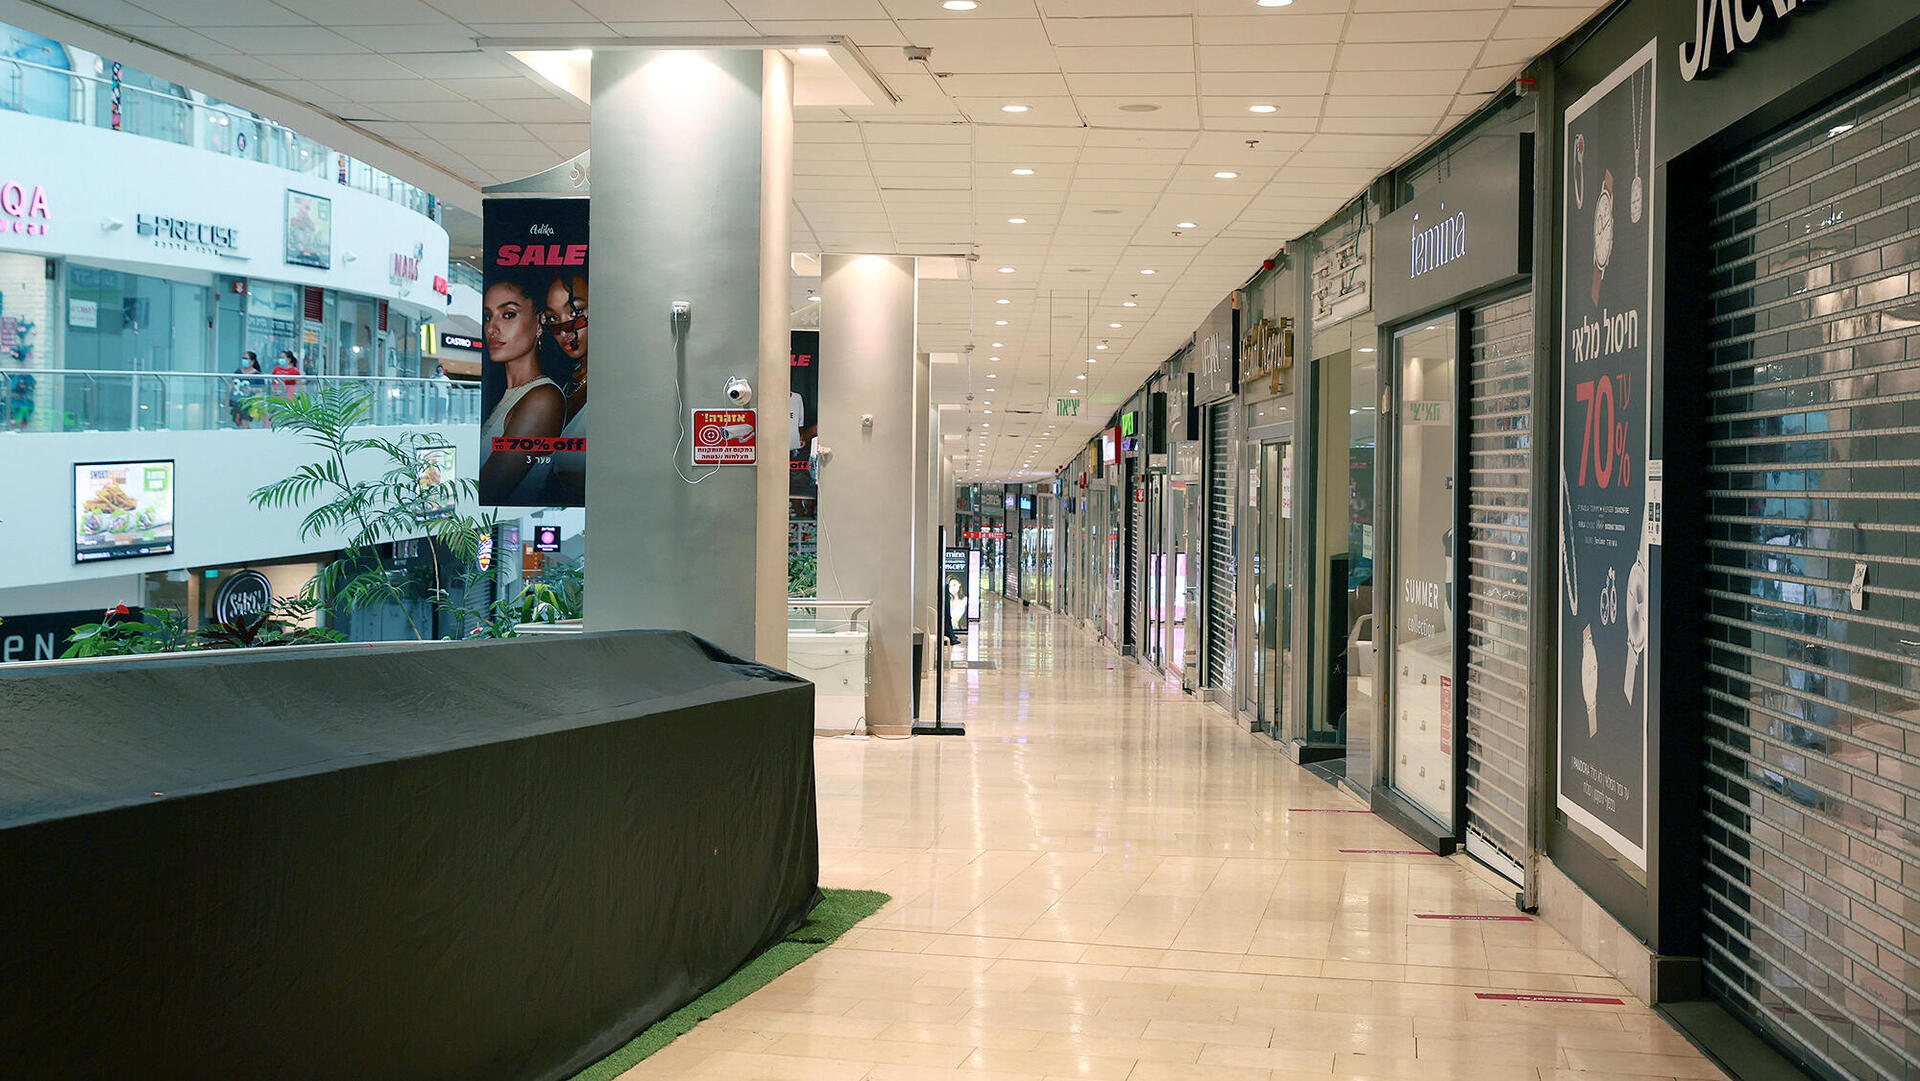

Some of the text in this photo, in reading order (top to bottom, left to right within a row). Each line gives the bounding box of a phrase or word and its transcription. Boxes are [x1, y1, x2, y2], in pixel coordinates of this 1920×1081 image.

[529, 224, 554, 236] Adika
[1411, 202, 1466, 279] femina
[496, 244, 588, 266] SALE
[445, 336, 472, 348] CASTRO
[1572, 308, 1638, 363] חיסול מלאי
[790, 354, 811, 366] LE
[1616, 372, 1632, 411] עד
[1057, 399, 1080, 416] יציאה
[704, 413, 745, 422] אזהרה!
[506, 439, 584, 450] 70% off
[526, 455, 551, 464] שער 3
[1405, 578, 1439, 609] SUMMER
